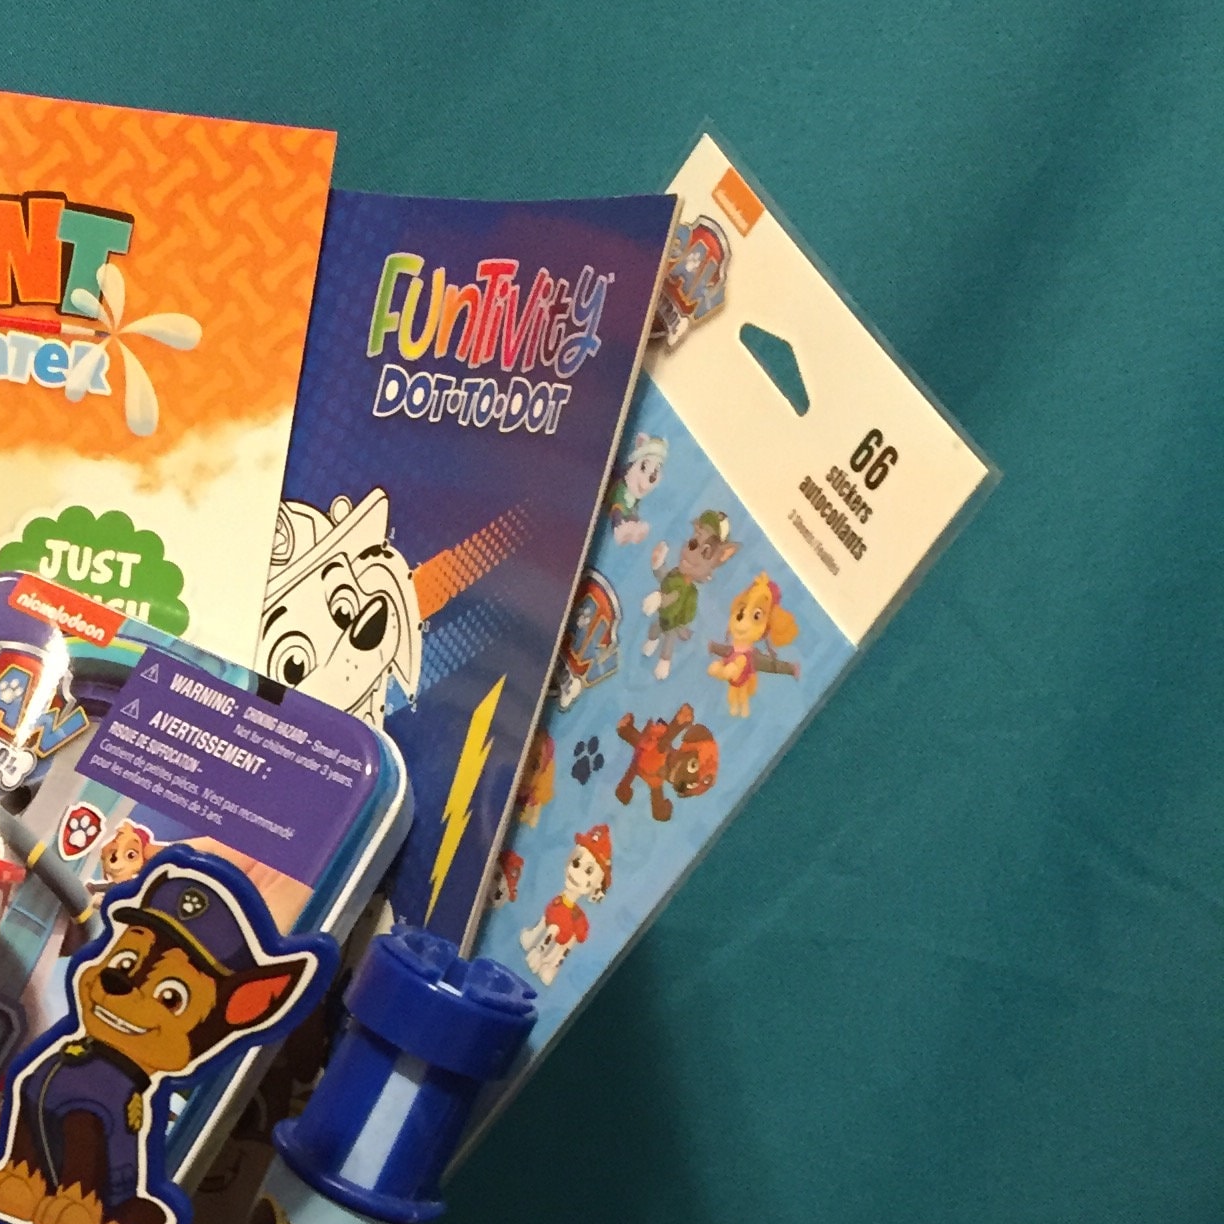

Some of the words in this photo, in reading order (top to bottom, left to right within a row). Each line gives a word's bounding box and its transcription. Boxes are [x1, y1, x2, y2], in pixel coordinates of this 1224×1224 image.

[849, 427, 899, 491] 66
[798, 475, 868, 562] autocollants
[825, 465, 874, 525] stickers
[38, 538, 142, 589] JUST
[150, 712, 263, 772] AVERTISSEMENT
[170, 674, 237, 716] WARNING:
[311, 739, 339, 759] Small
[233, 723, 251, 738] Not
[262, 739, 295, 759] children
[294, 755, 320, 770] under
